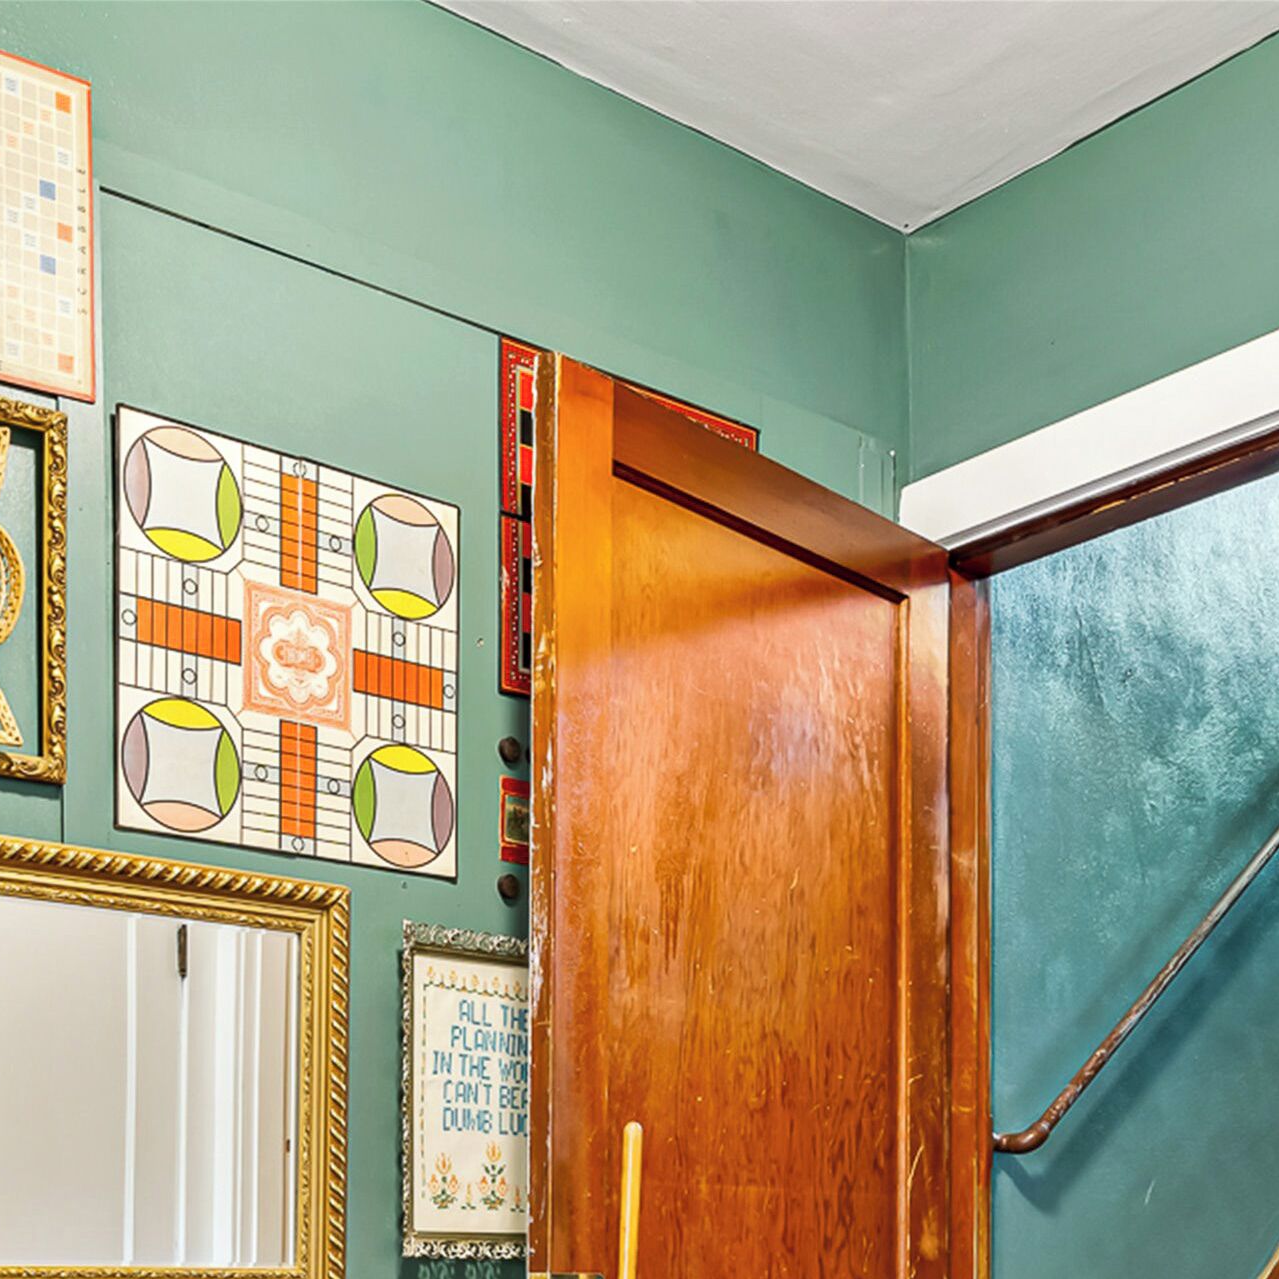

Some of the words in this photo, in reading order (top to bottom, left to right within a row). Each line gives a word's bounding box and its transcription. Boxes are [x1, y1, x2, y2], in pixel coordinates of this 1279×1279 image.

[458, 999, 492, 1027] ALL
[500, 1003, 528, 1032] THE
[433, 1050, 452, 1075] IN
[459, 1052, 491, 1081] THE
[443, 1078, 492, 1106] CAN'T
[443, 1106, 493, 1135] DUMB
